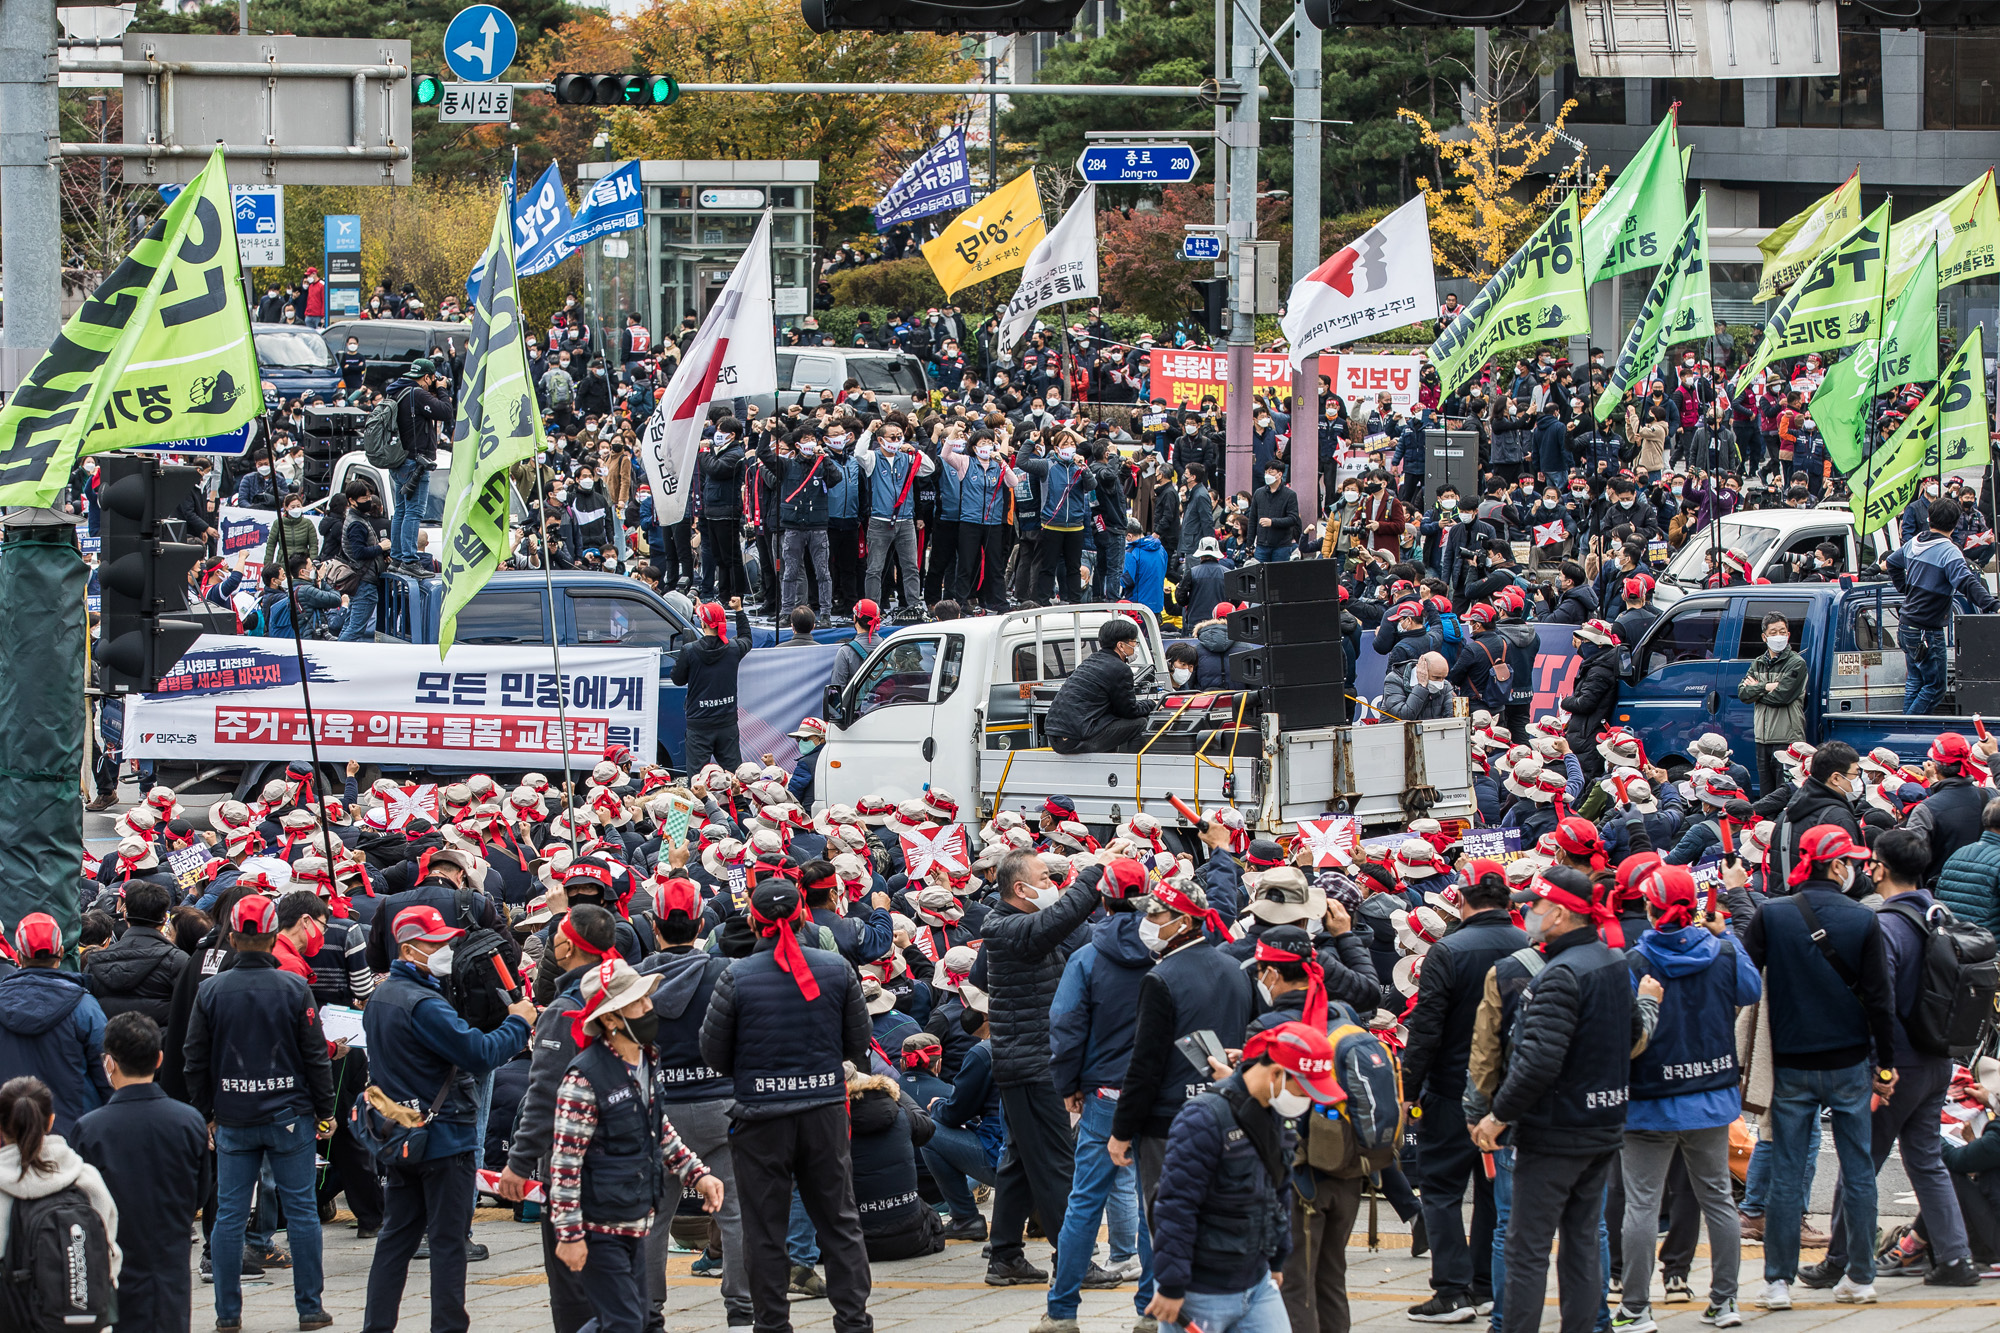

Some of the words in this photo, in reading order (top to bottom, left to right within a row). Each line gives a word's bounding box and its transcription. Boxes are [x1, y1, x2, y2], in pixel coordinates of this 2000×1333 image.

[443, 91, 509, 115] 동시신호
[1087, 158, 1107, 171] 284
[1125, 150, 1153, 167] 종로
[1170, 158, 1190, 170] 280
[1120, 168, 1158, 180] Jong-ro
[638, 336, 647, 351] 2
[1162, 355, 1212, 380] 노동중심
[1347, 367, 1412, 391] 진보당
[219, 657, 256, 669] 대전환!
[197, 669, 235, 689] 세상을
[238, 663, 282, 685] 바꾸자!
[415, 671, 487, 706] 모든
[500, 673, 644, 711] 민중에게
[156, 733, 197, 745] 민주노총
[1481, 832, 1504, 841] 위원장
[1504, 829, 1521, 839] 석방
[1463, 840, 1506, 858] 민주노총
[1298, 1057, 1323, 1072] 단결
[1663, 1054, 1733, 1081] 전국건설노동조합
[221, 1076, 295, 1093] 전국건설노동조합
[755, 1073, 836, 1092] 전국건설노동조합
